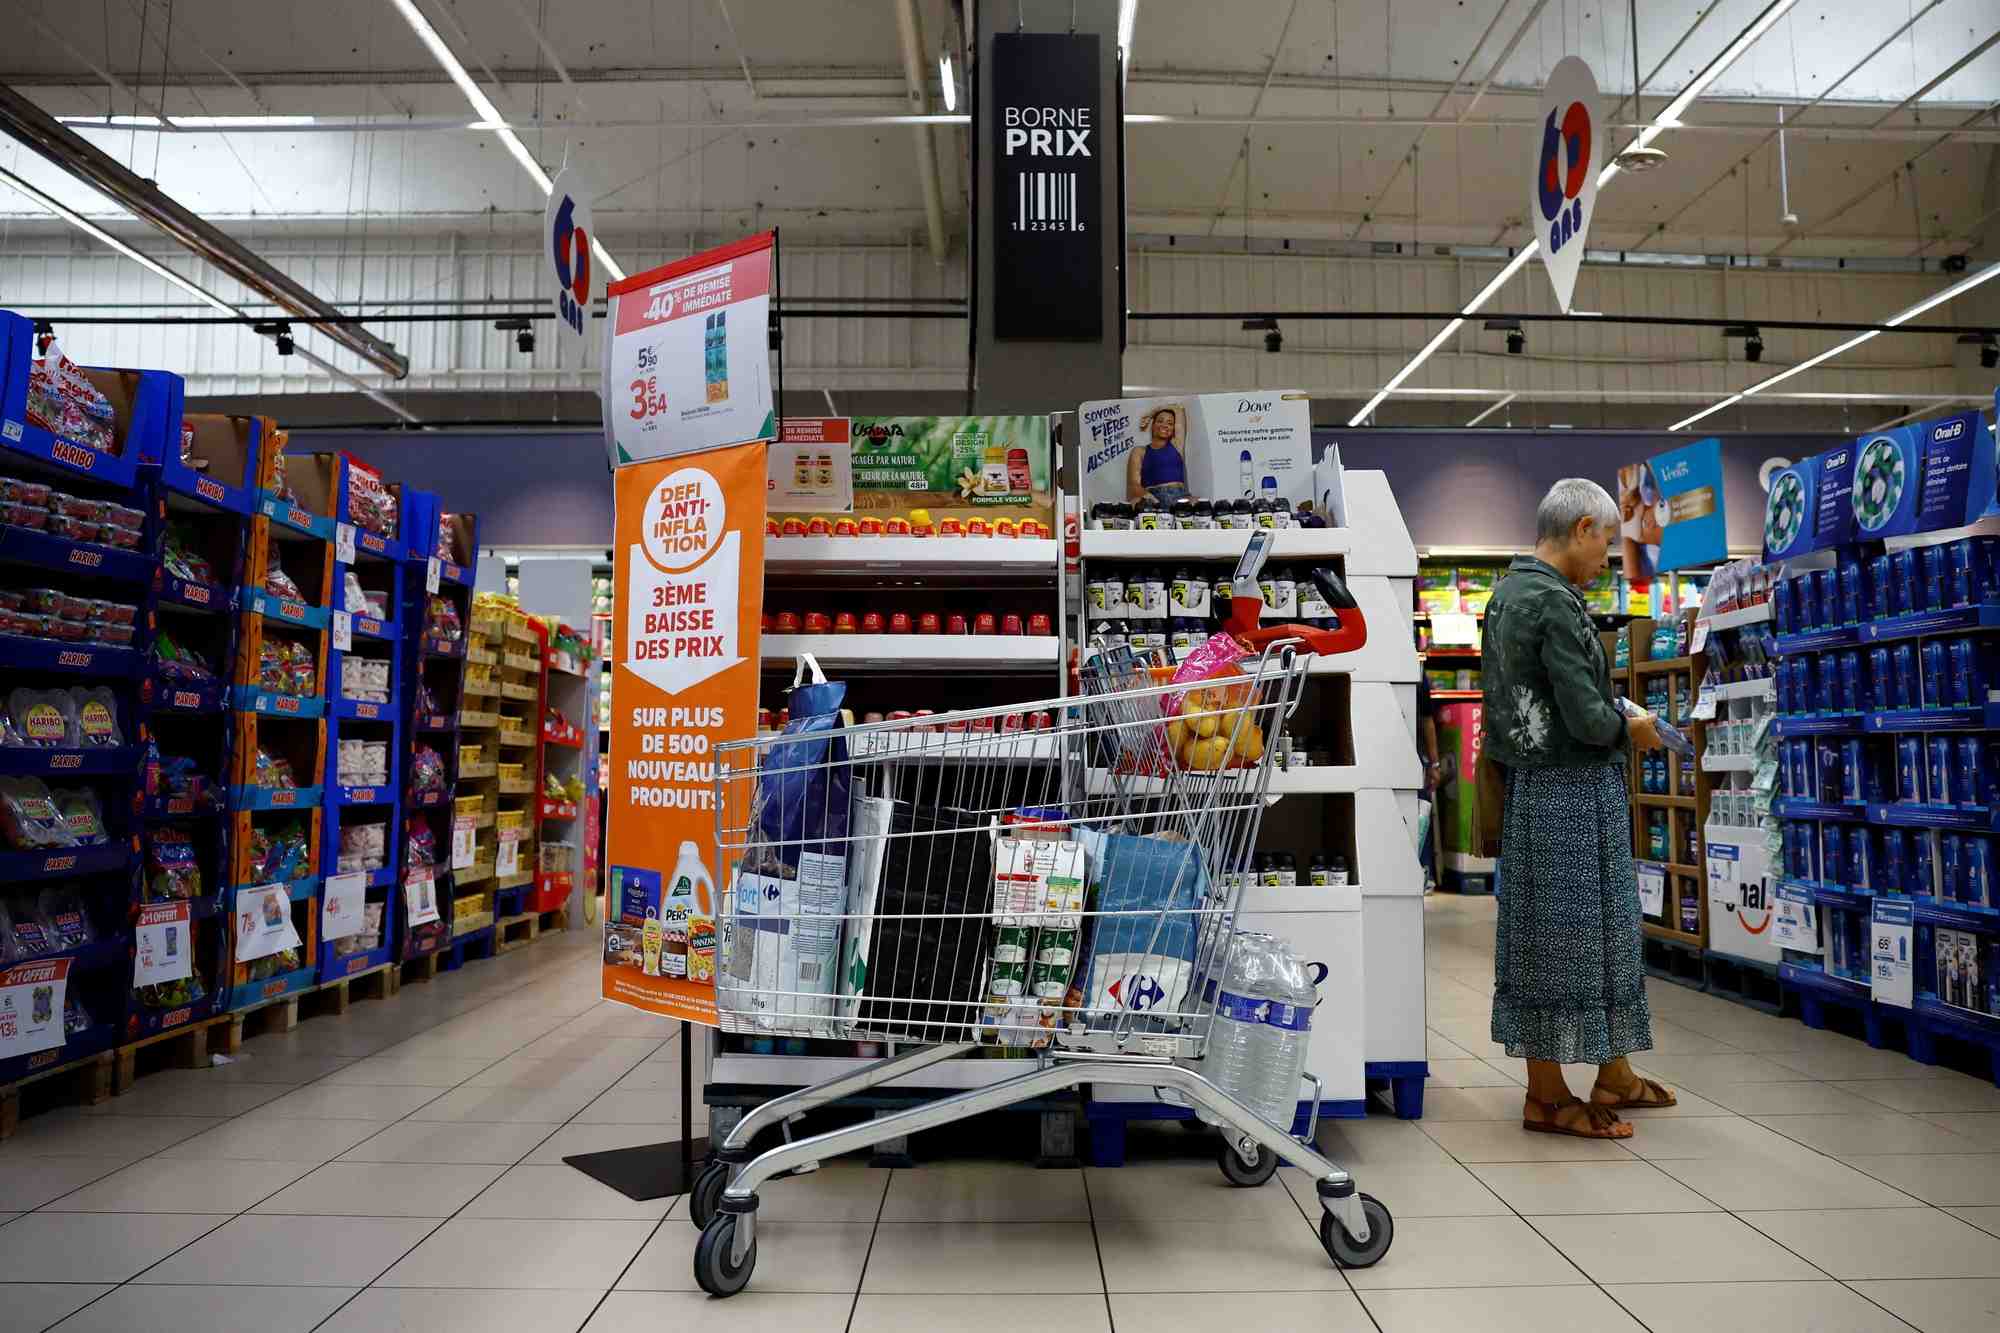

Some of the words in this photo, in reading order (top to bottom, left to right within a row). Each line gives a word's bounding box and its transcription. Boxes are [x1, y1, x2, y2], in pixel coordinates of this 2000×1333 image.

[1004, 107, 1091, 127] BORNE
[1005, 129, 1092, 157] PRIX
[683, 286, 695, 299] DE
[696, 276, 731, 296] REMISE
[1084, 404, 1121, 424] SOYONS
[1238, 399, 1272, 414] Dove
[1934, 423, 1962, 440] Oral-B
[52, 439, 95, 471] HARIBO
[876, 455, 889, 465] PAR
[1087, 436, 1135, 474] AISSELLES
[196, 477, 225, 502] HARIBO
[910, 481, 927, 489] 48H
[287, 508, 312, 527] HARIBO
[661, 498, 711, 521] ANTI-
[653, 516, 707, 539] INFLA
[662, 534, 708, 554] TION
[69, 549, 102, 567] HARIBO
[184, 583, 209, 603] HARIBO
[652, 580, 707, 607] 3ÈME
[280, 600, 304, 619] HARIBO
[644, 609, 714, 634] BAISSE
[635, 638, 670, 660] DES
[674, 635, 725, 658] PRIX
[58, 651, 92, 667] HARIBO
[29, 715, 61, 727] HARIBO
[83, 711, 110, 723] HARIBO
[632, 707, 667, 728] SUR
[671, 707, 725, 728] PLUS
[642, 734, 665, 753] DE
[668, 734, 709, 755] 500
[50, 753, 83, 768] HARIBO
[153, 909, 178, 924] OFFERT
[23, 966, 57, 983] OFFERT
